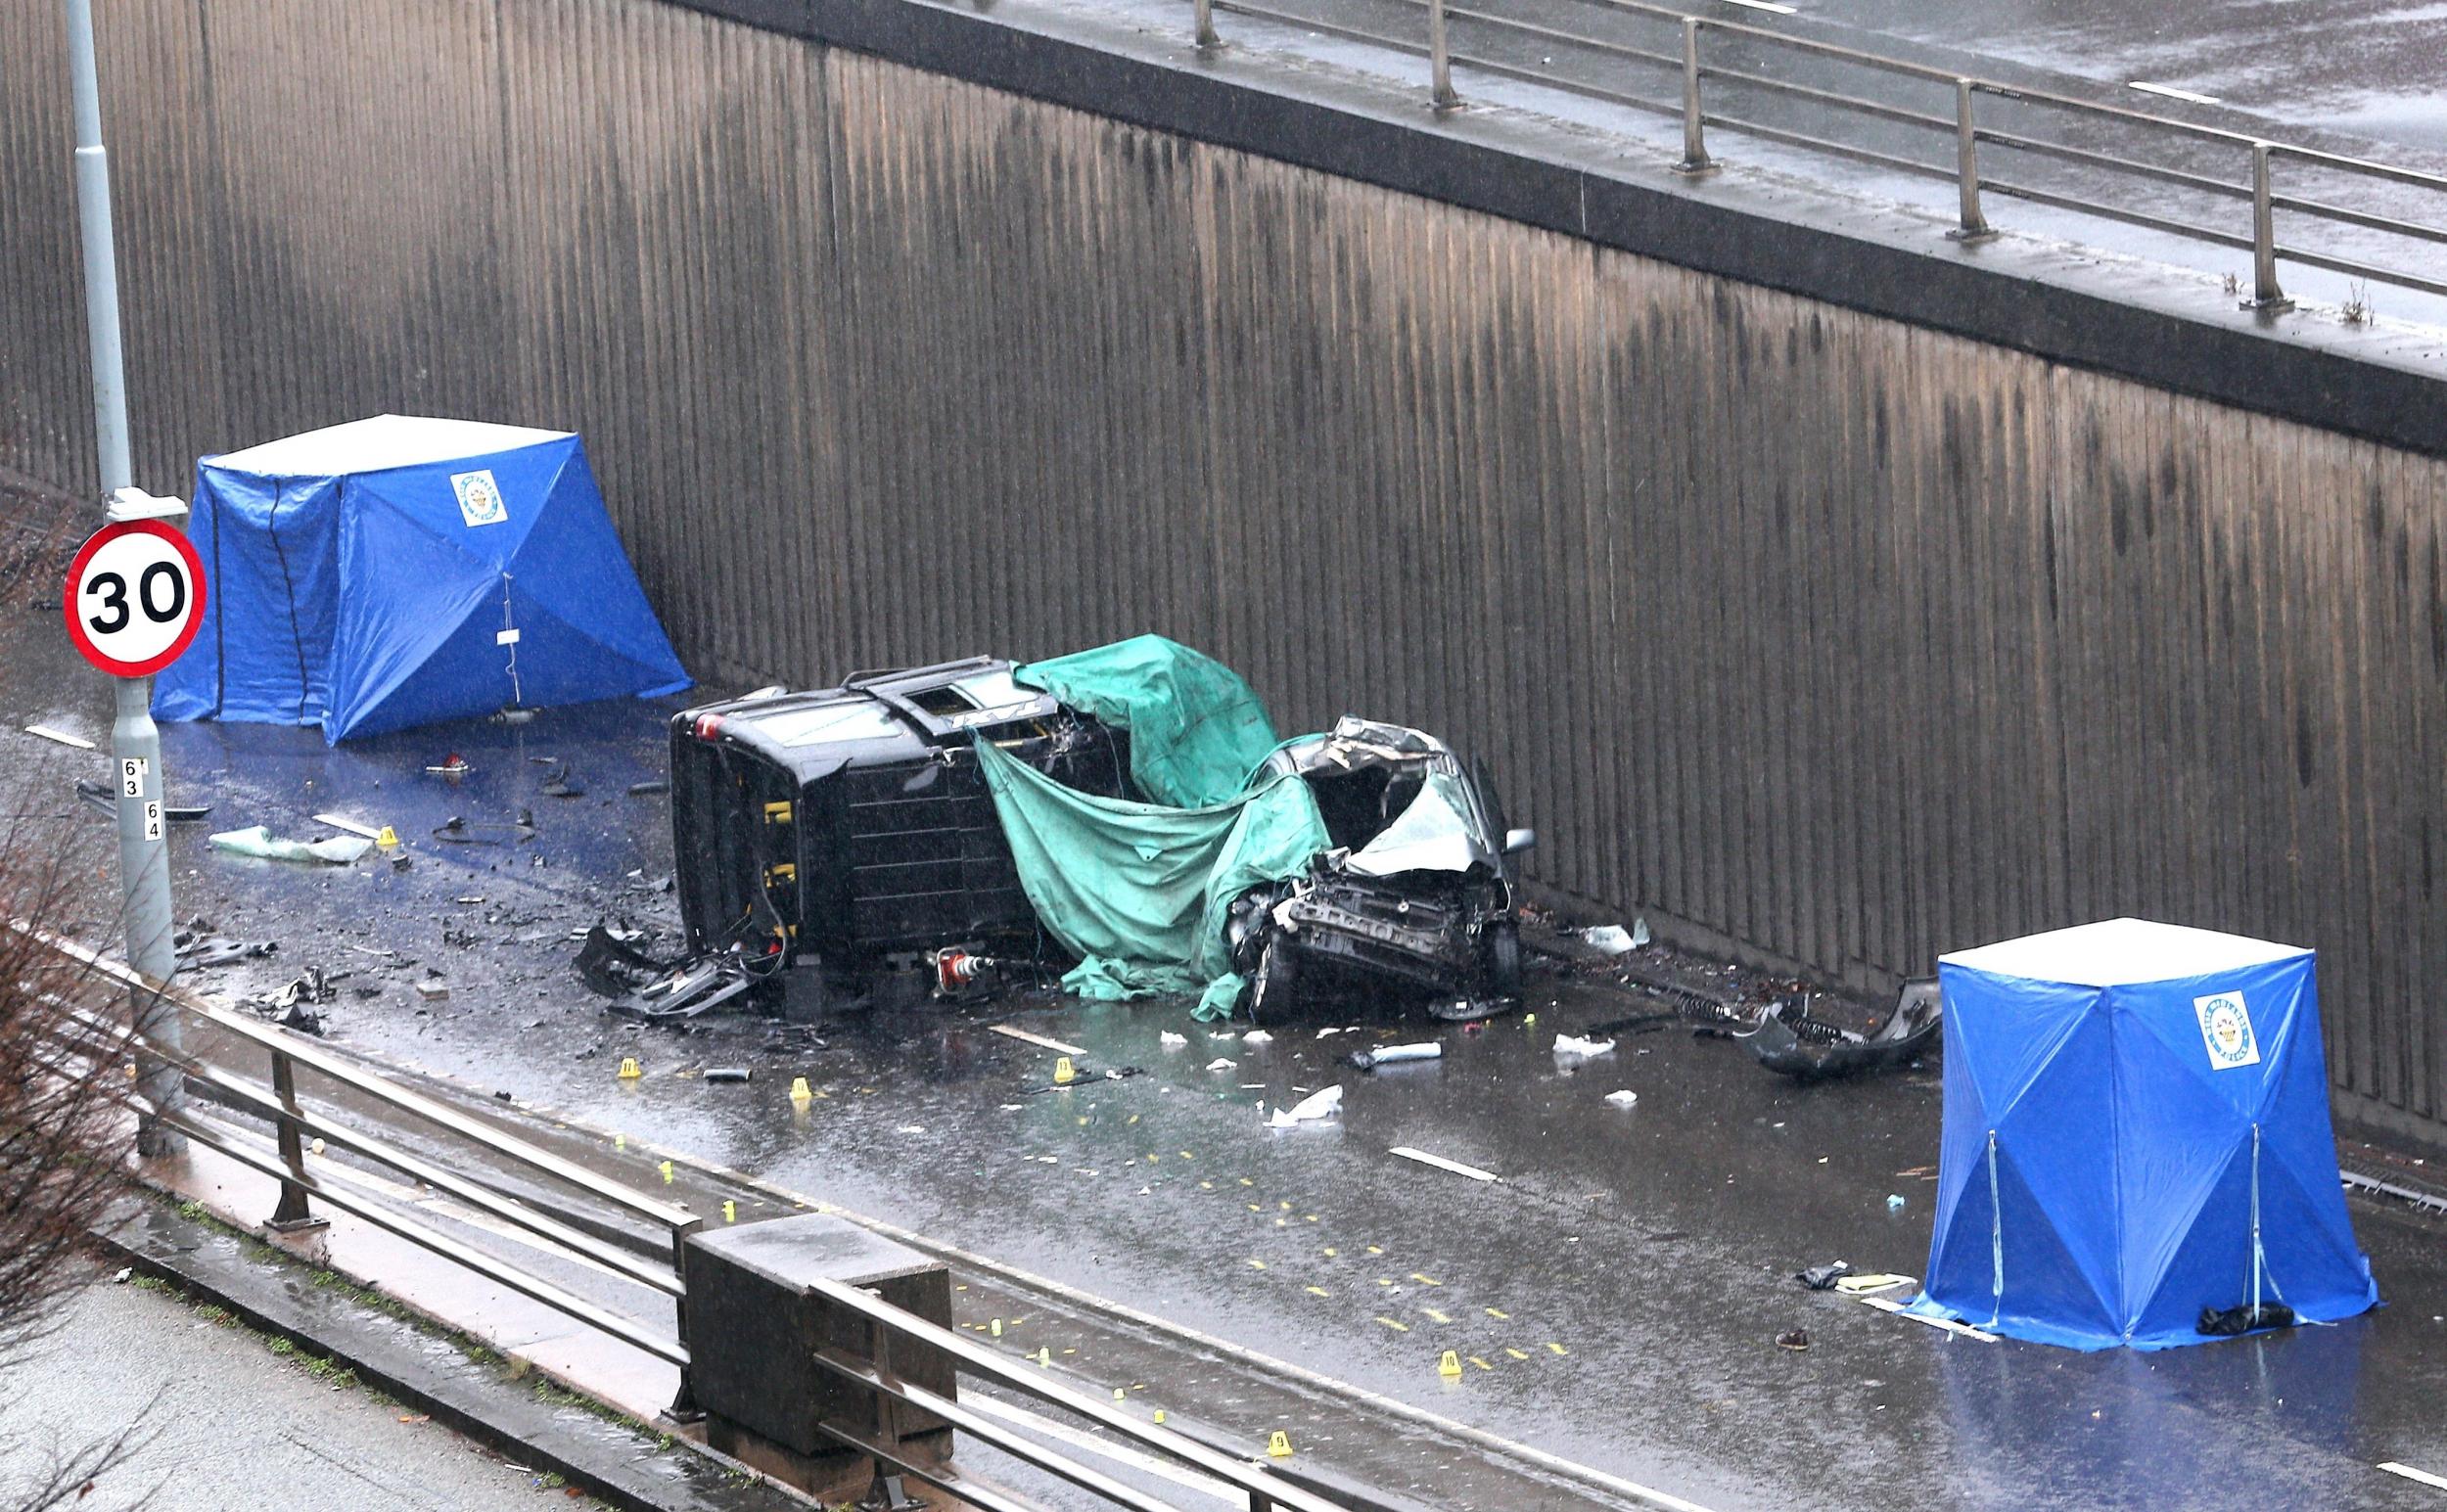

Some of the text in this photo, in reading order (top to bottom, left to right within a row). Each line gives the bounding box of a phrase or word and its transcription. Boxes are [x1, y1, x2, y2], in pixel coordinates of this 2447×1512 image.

[85, 561, 185, 634] 30
[951, 702, 1041, 729] TAXI
[623, 1062, 631, 1073] 11
[1059, 1061, 1068, 1071] 13
[797, 1081, 805, 1091] 12
[1446, 1355, 1455, 1366] 10
[1276, 1436, 1284, 1447] 9
